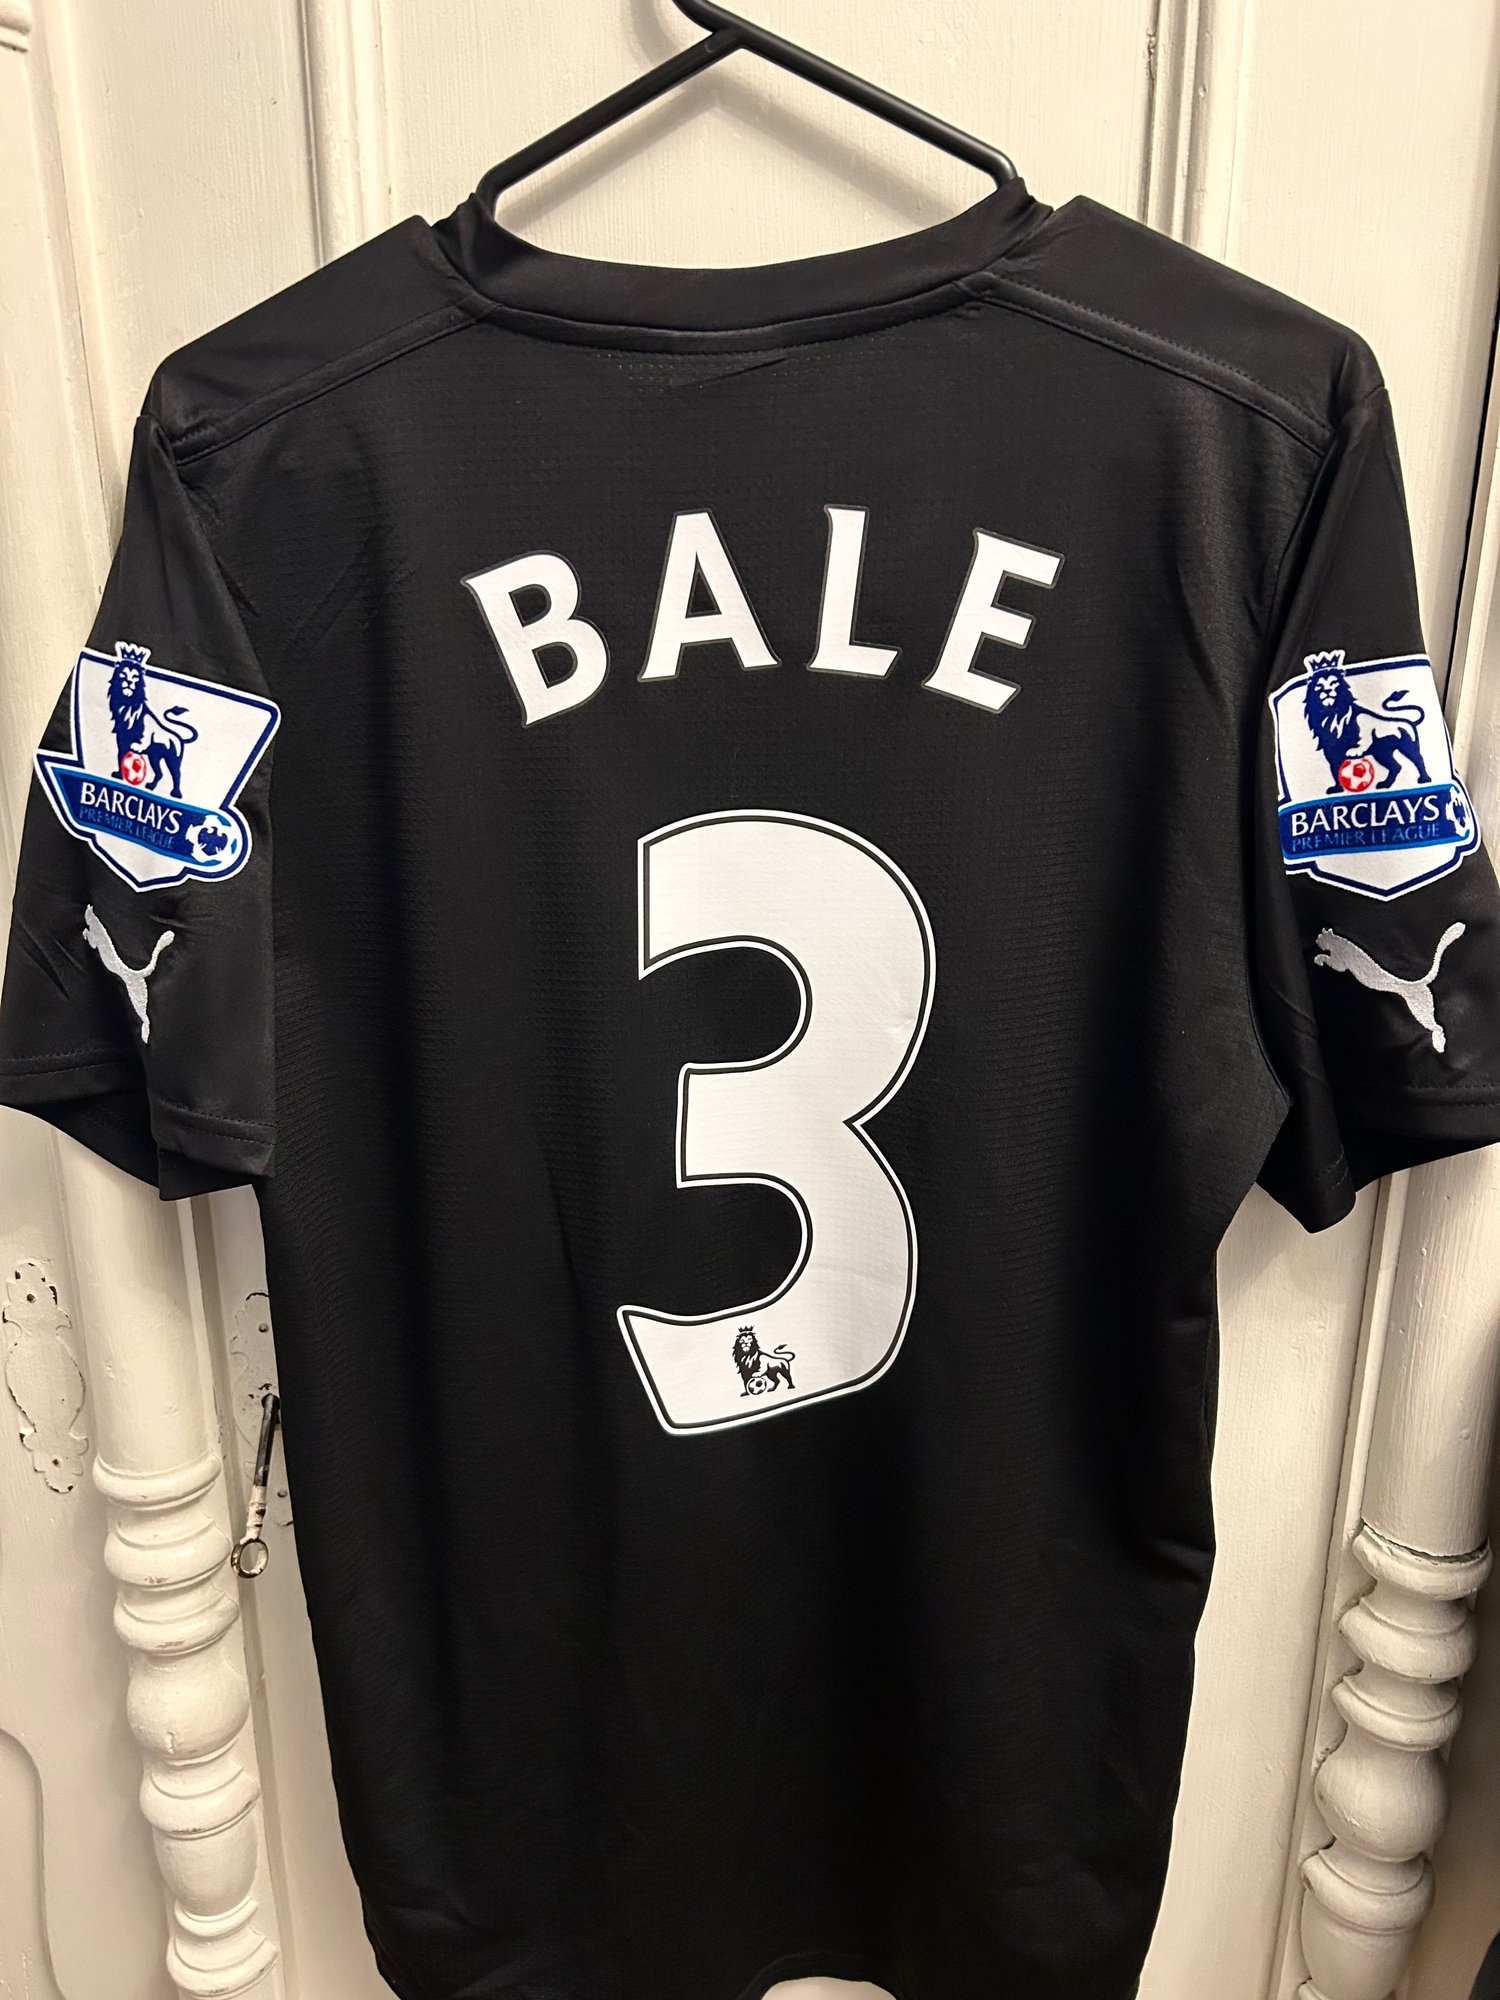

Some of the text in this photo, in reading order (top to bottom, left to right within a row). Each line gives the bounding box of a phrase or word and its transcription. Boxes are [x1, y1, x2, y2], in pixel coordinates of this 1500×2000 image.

[460, 504, 1065, 727] BALE
[80, 781, 183, 834] BARCLAYS
[80, 806, 176, 849] PREMIER LEAGUE
[1291, 795, 1440, 837] BARCLAYS
[1292, 822, 1441, 852] PREMIER LEAGUE
[617, 809, 936, 1435] 3
